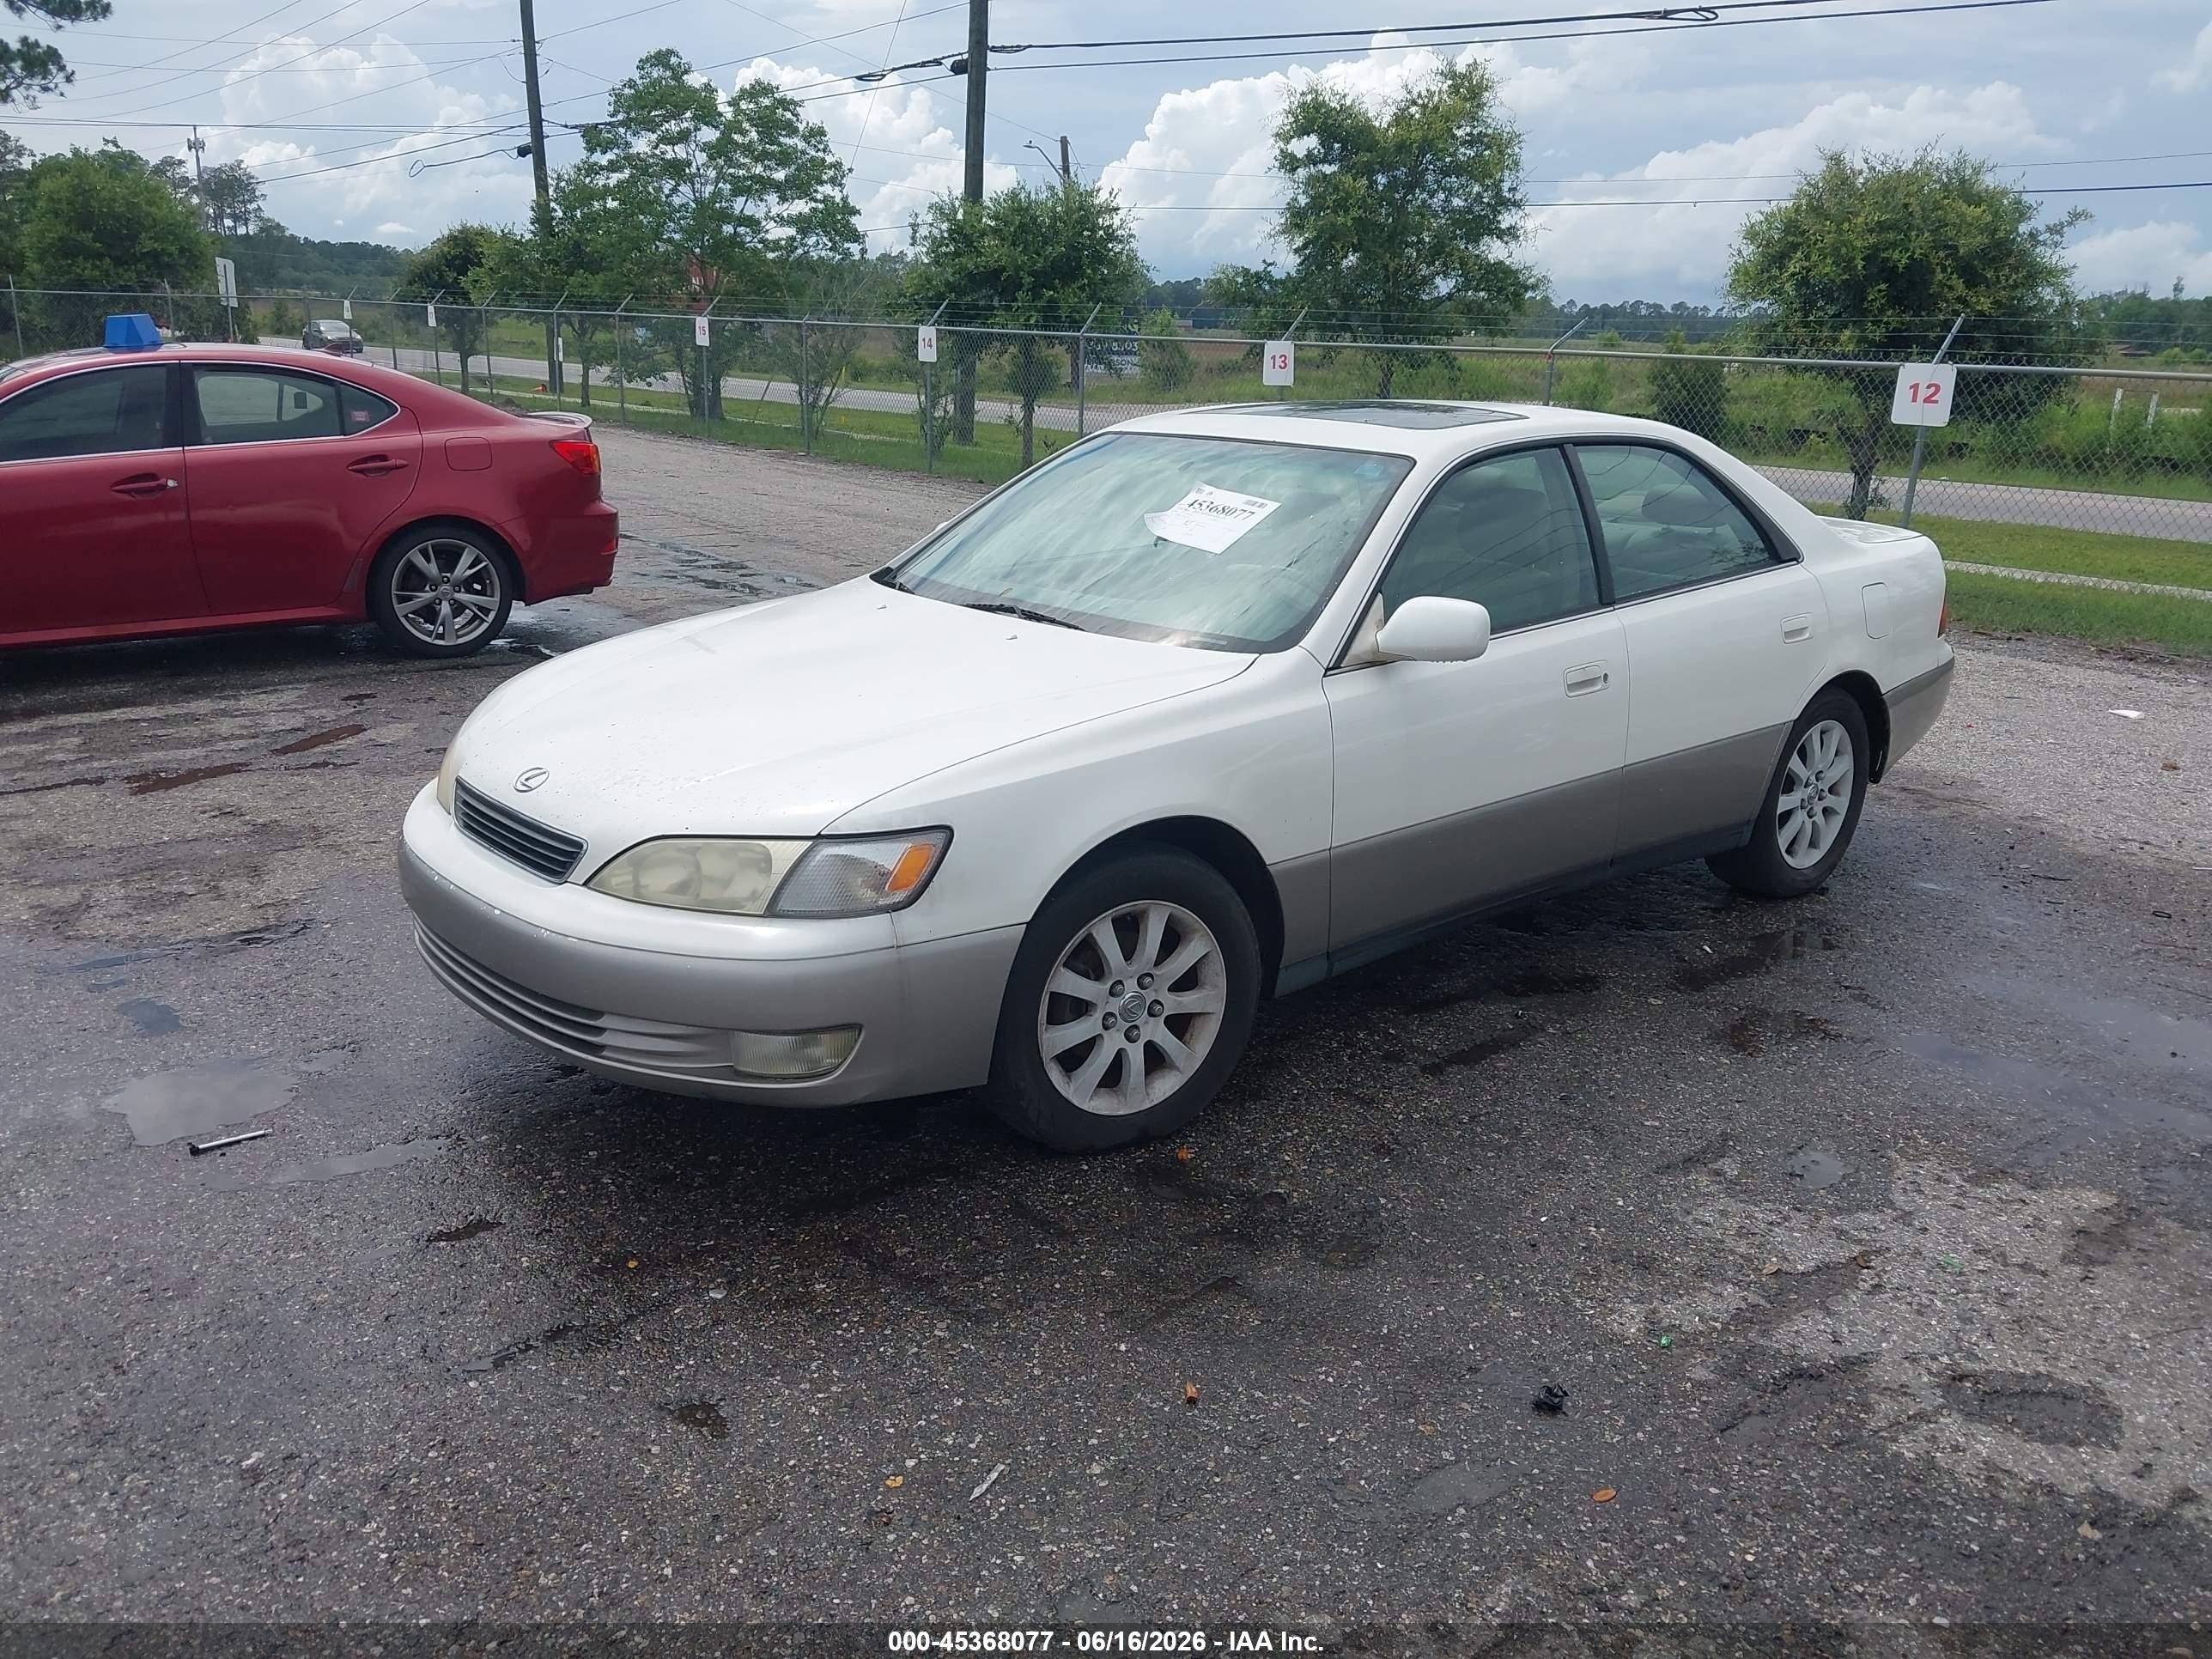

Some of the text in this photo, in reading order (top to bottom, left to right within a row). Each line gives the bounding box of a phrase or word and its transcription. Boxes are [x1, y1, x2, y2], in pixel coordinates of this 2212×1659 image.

[698, 325, 707, 336] 15
[921, 337, 933, 349] 14
[1270, 353, 1288, 370] 13
[1909, 382, 1942, 404] 12
[1187, 498, 1256, 521] 45368077
